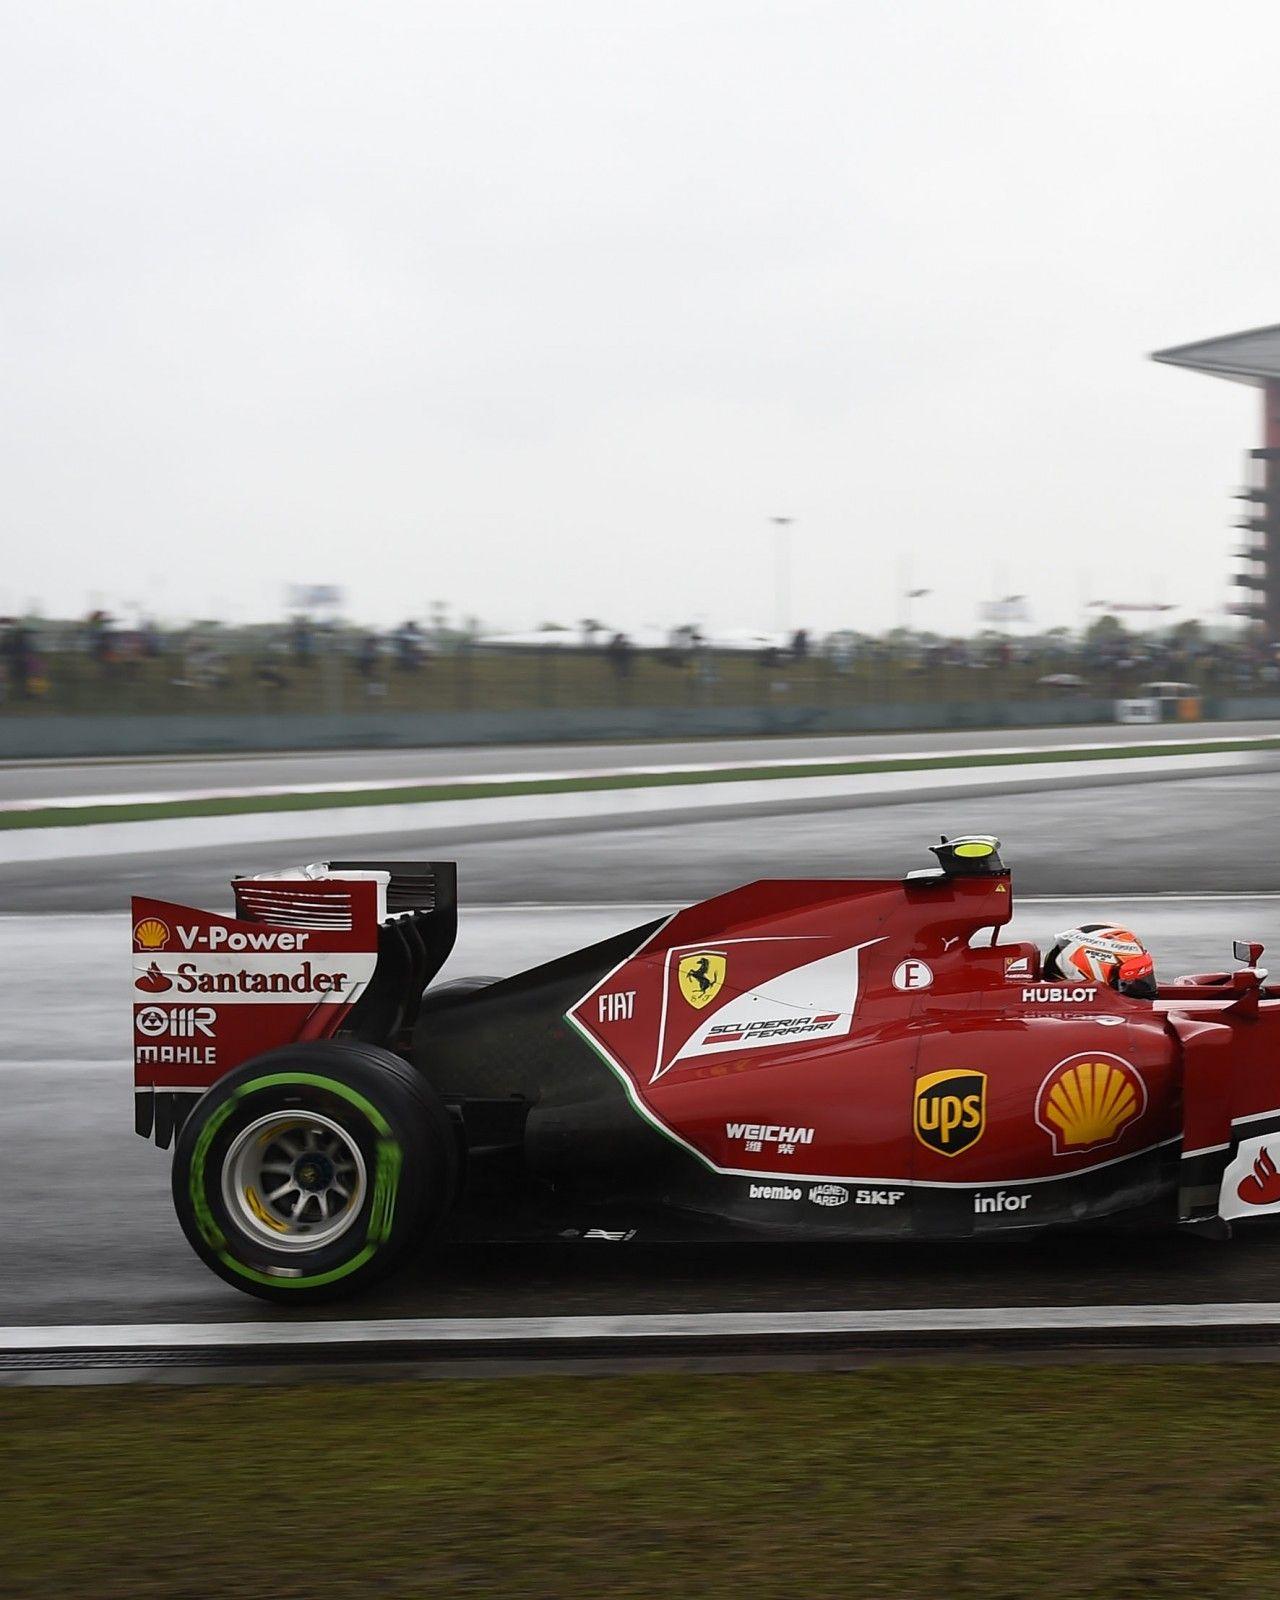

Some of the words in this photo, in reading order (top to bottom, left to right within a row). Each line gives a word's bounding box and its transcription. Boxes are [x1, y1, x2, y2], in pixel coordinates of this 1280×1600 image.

[176, 926, 308, 950] V-Power
[177, 962, 347, 993] Santander
[905, 963, 919, 987] E
[1022, 988, 1097, 1002] HUBLOT
[599, 991, 636, 1022] FIAT
[709, 1017, 811, 1035] SCUDERIA
[744, 1022, 833, 1040] FERRARI
[136, 1046, 216, 1064] MAHLE
[919, 1095, 980, 1143] ups
[726, 1123, 815, 1145] WEICHAI
[749, 1184, 802, 1201] brembo
[855, 1190, 905, 1205] SKF
[974, 1191, 1031, 1213] infor
